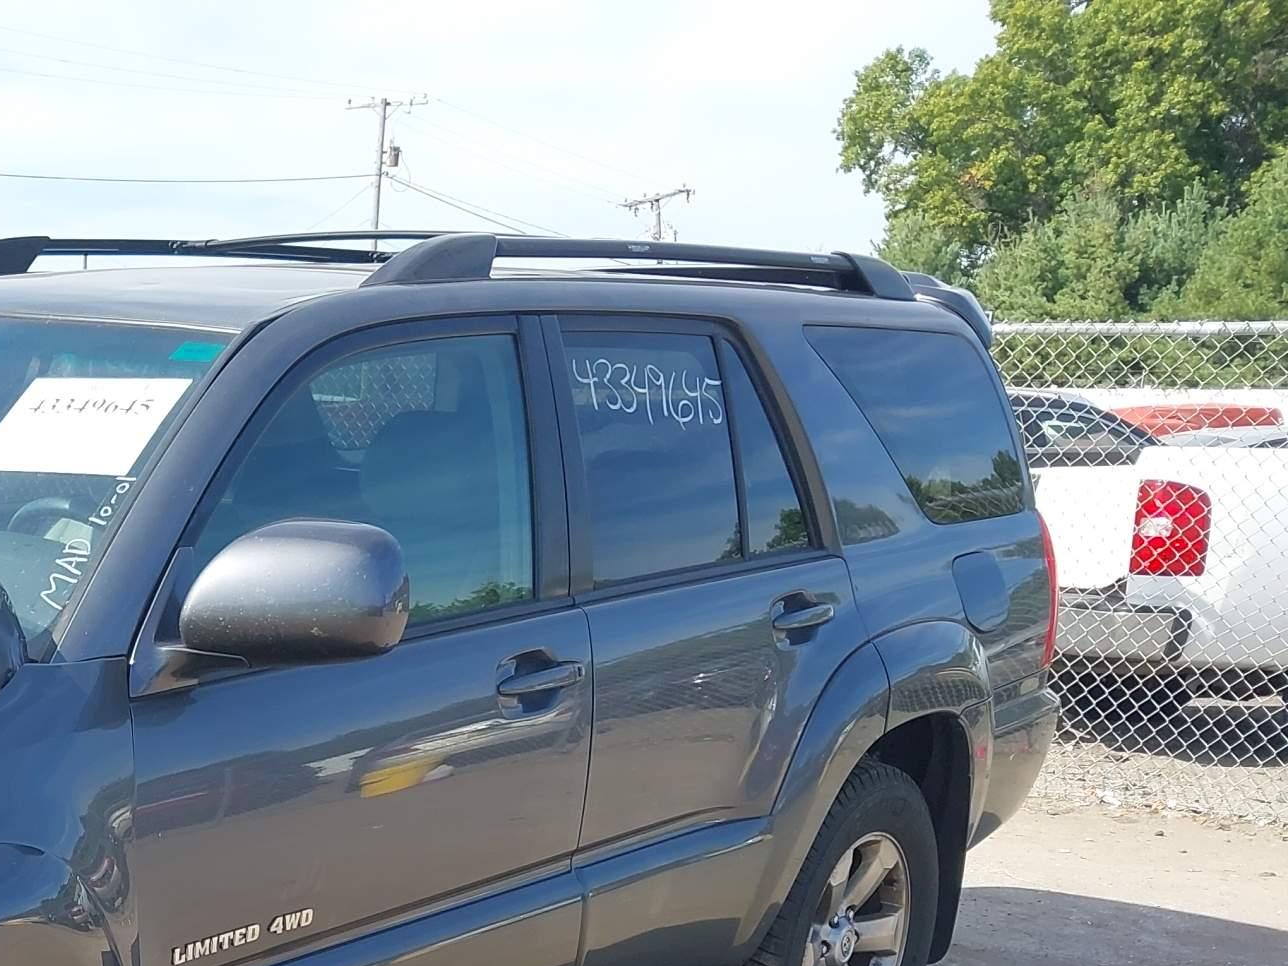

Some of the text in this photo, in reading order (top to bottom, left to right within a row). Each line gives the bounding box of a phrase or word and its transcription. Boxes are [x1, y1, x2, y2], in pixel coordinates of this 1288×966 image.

[572, 358, 723, 430] 43349645
[40, 475, 137, 610] MAD 10-01
[172, 907, 314, 966] LIMITED 4WD
